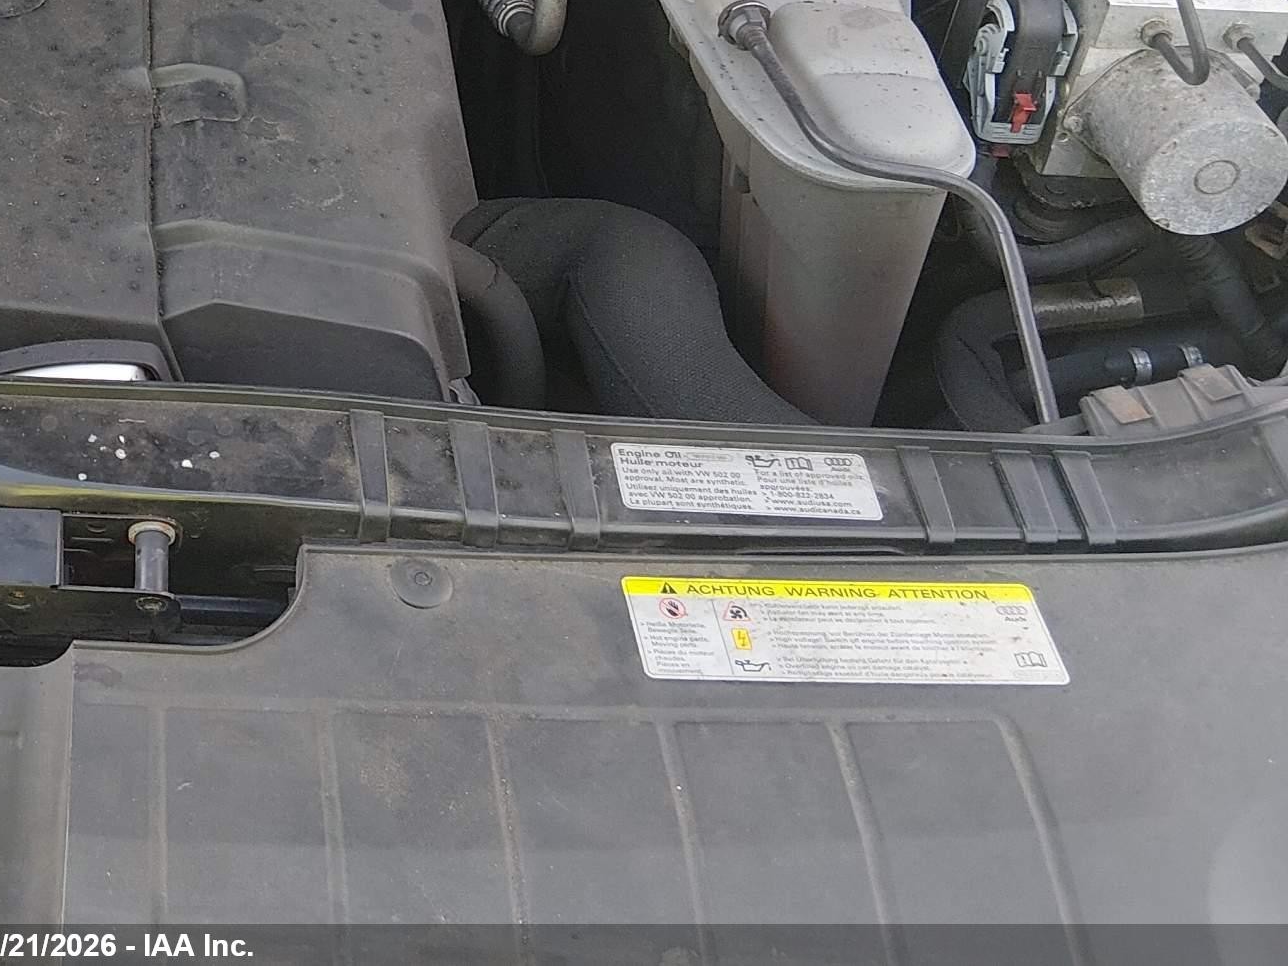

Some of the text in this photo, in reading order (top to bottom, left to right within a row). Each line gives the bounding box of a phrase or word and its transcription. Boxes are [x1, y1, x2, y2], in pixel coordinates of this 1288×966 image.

[618, 448, 661, 458] Engine
[620, 457, 652, 465] Huile
[686, 584, 989, 600] ACHTUNG WARNING ATTENTION
